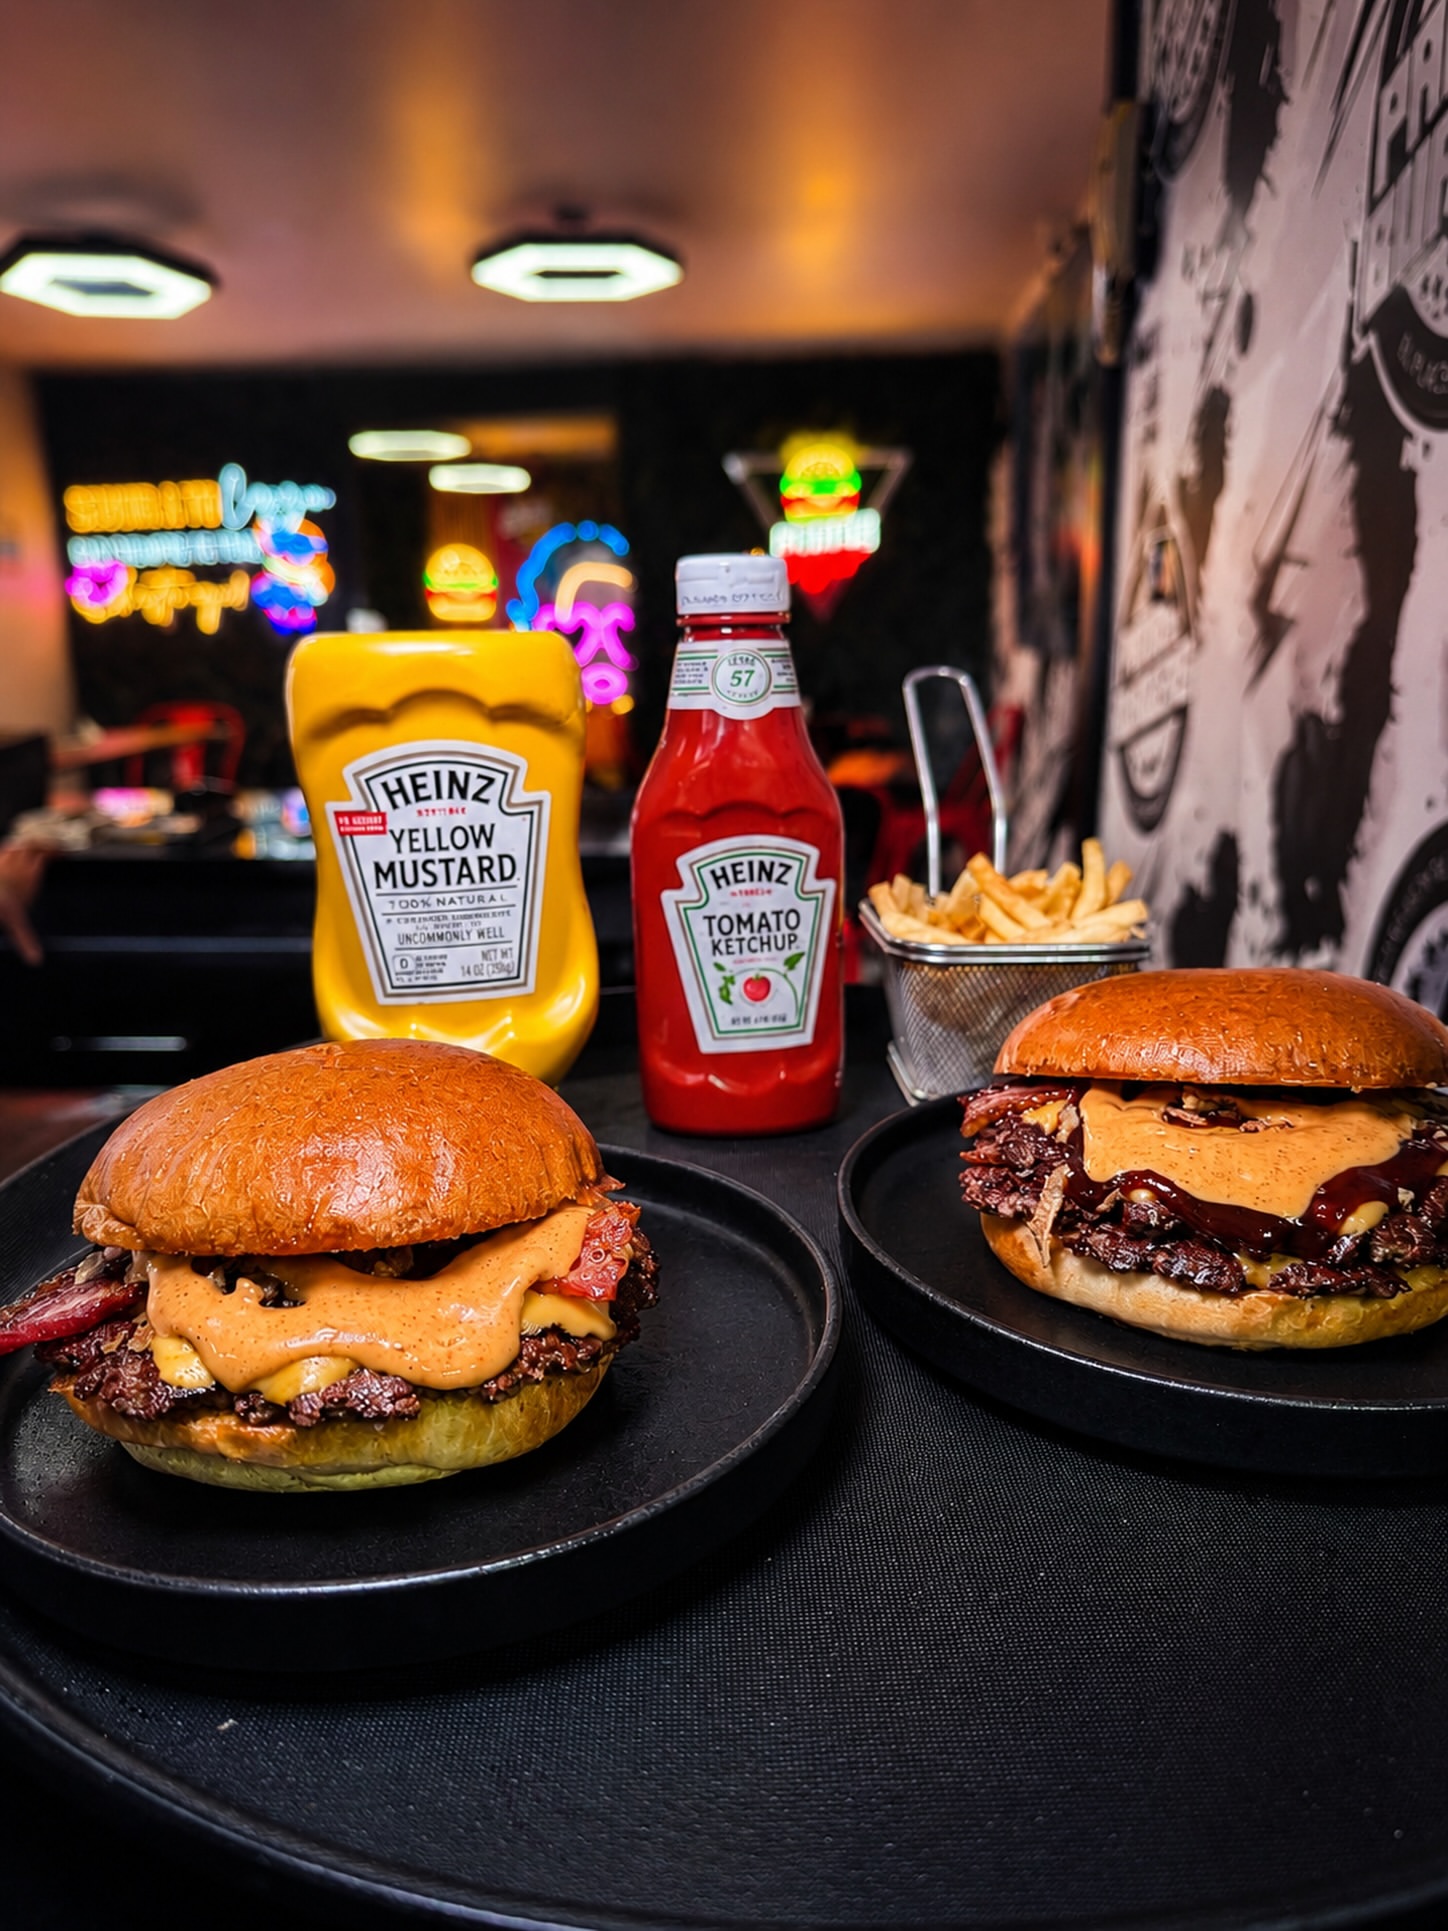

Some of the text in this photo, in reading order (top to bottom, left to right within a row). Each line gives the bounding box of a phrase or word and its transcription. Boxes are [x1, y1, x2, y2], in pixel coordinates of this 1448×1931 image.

[730, 669, 755, 687] 57
[380, 769, 496, 811] HEINZ
[389, 823, 496, 854] YELLOW
[373, 854, 518, 889] MUSTARD
[710, 859, 793, 890] HEINZ
[436, 894, 507, 906] NATURAL
[397, 929, 471, 945] UNCOMMONLY
[476, 926, 505, 939] WELL
[703, 908, 801, 937] TOMATO
[711, 933, 798, 957] KETCHUP
